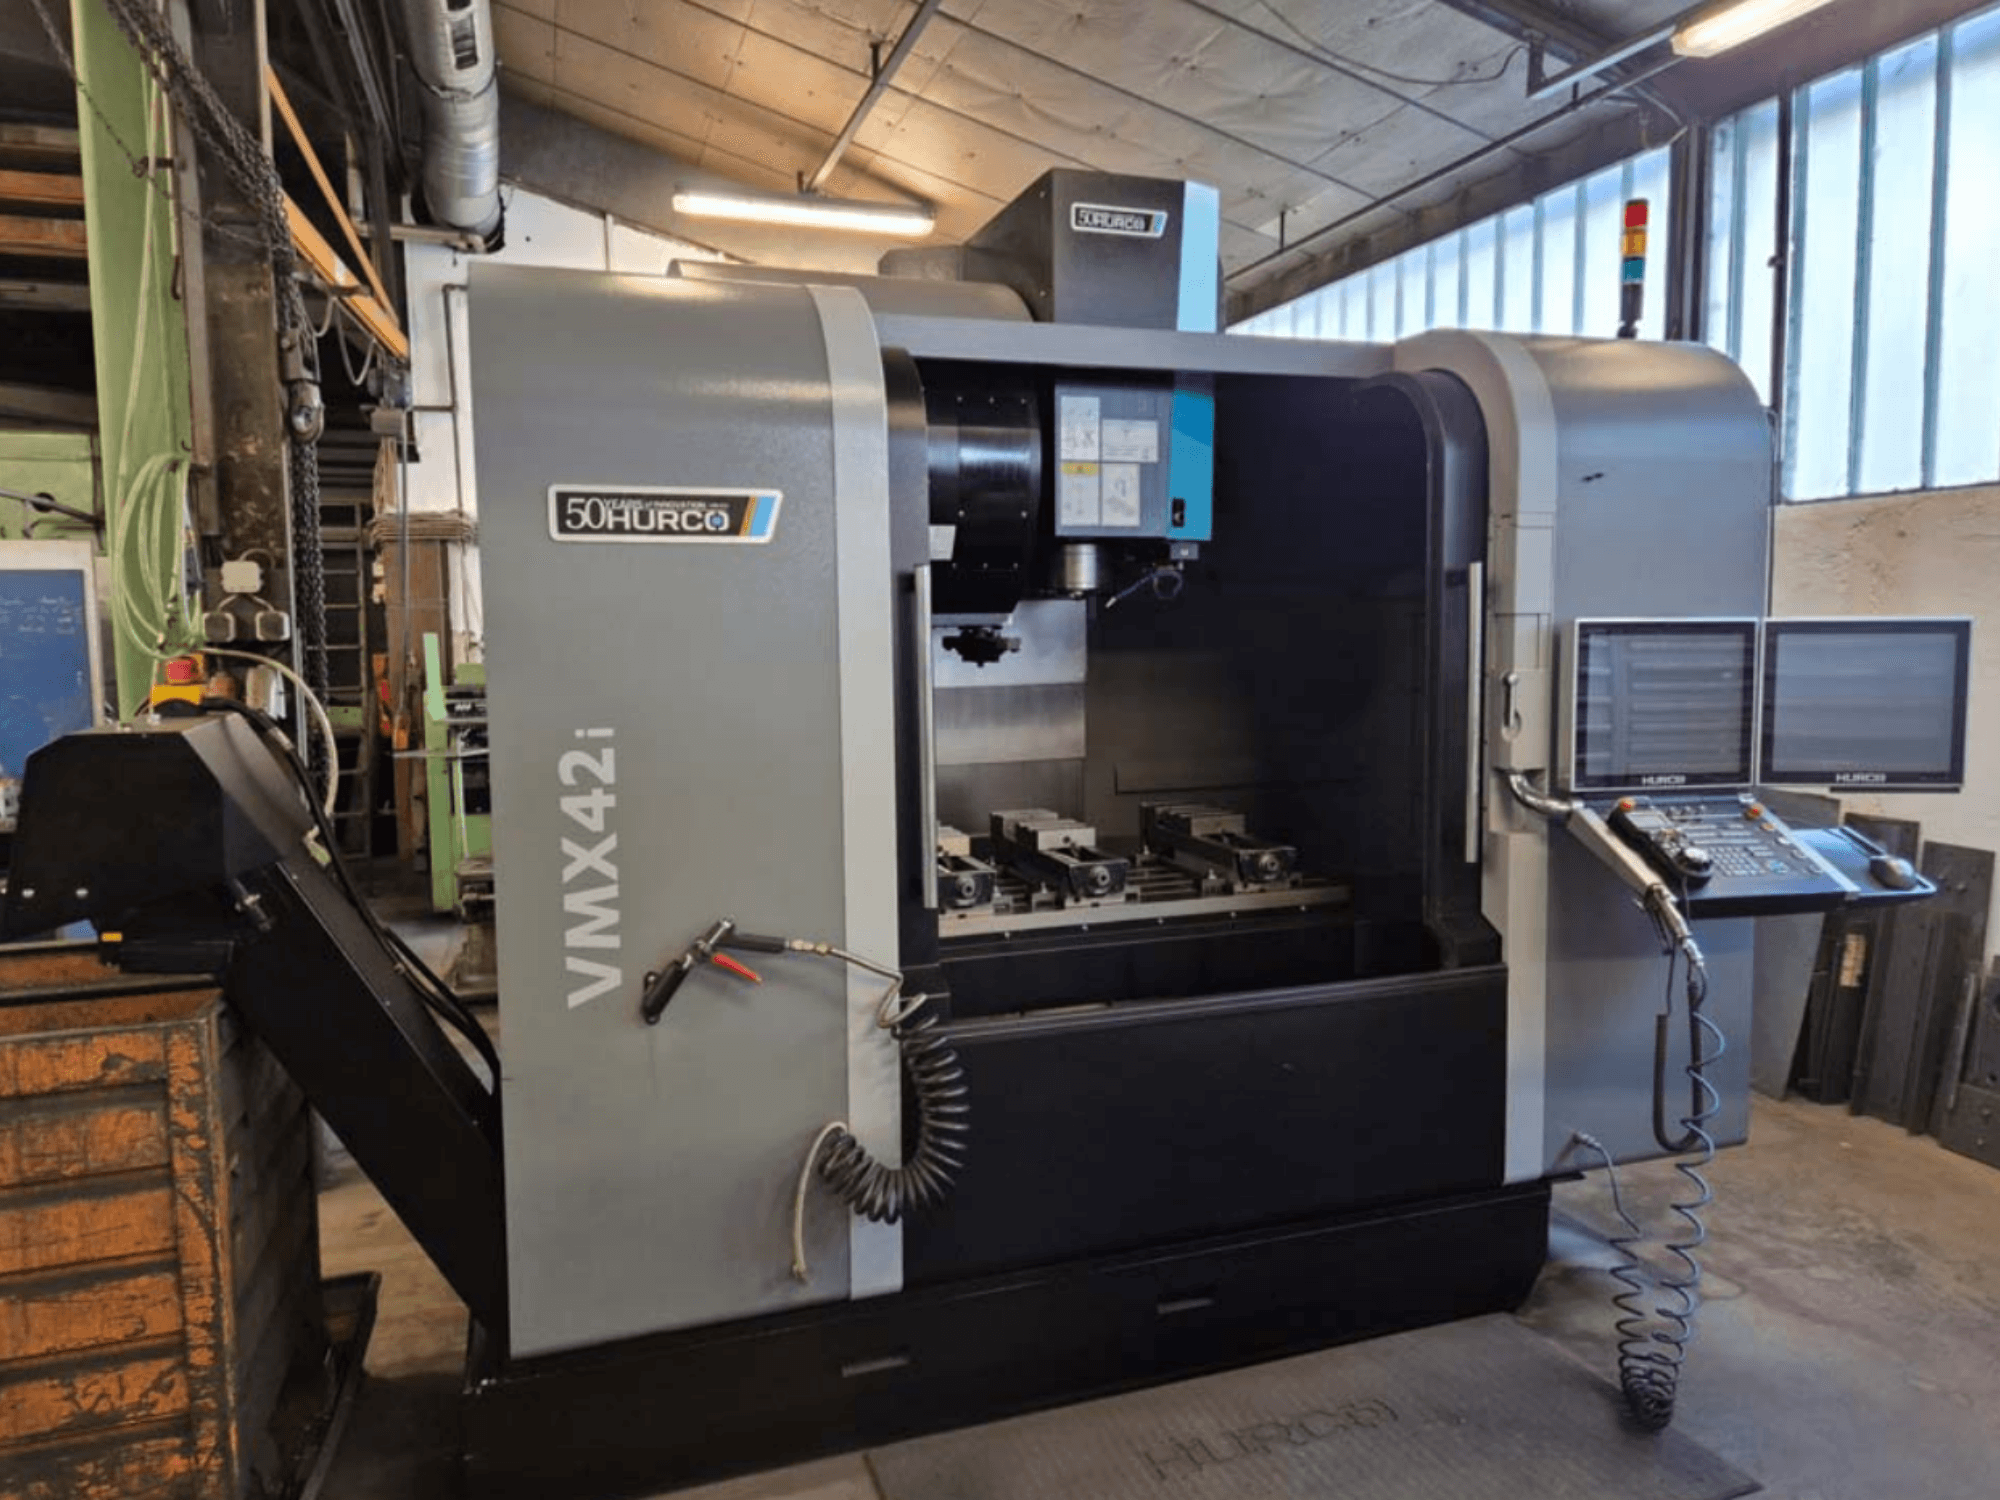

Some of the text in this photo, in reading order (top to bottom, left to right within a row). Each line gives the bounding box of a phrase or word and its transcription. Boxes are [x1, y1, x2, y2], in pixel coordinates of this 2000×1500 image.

[565, 497, 730, 532] 50 HURCO
[557, 727, 623, 1011] VMX42i
